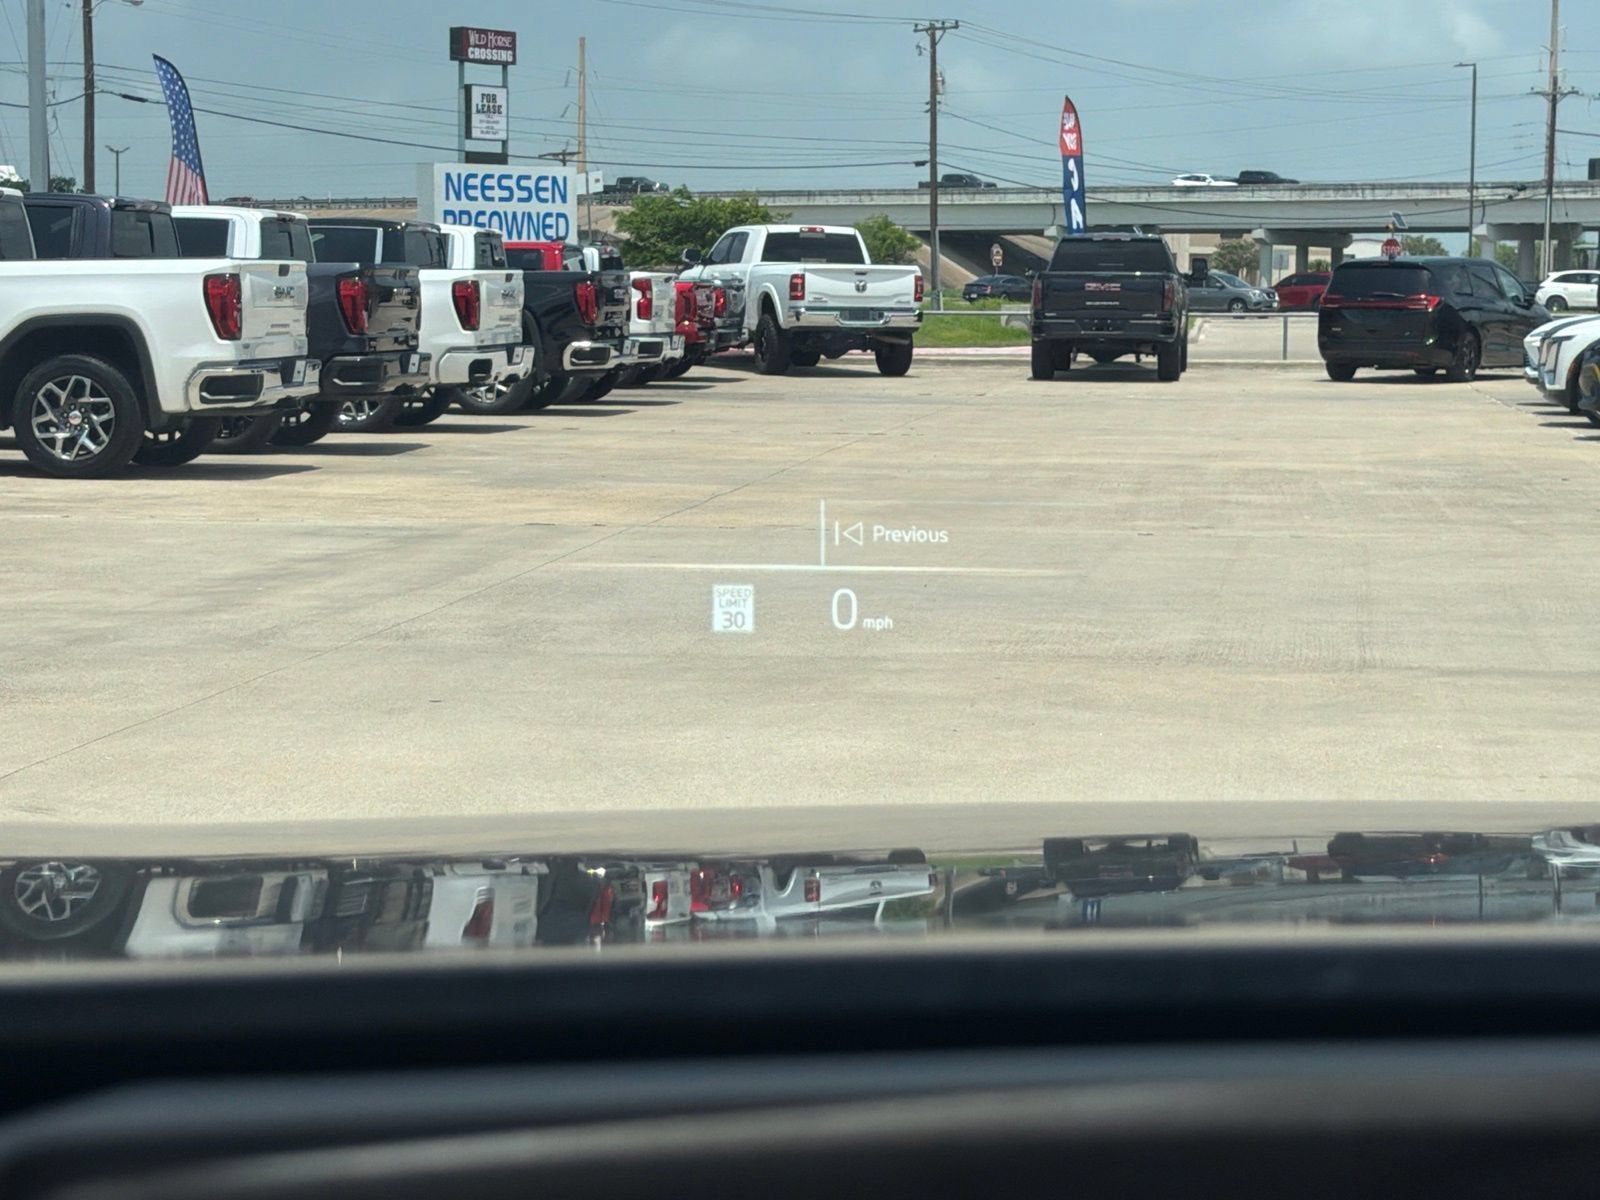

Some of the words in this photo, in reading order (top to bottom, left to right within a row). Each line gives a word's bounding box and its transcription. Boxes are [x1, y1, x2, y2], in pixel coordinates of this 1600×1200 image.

[467, 47, 513, 62] CROSSING
[481, 93, 497, 104] FOR
[476, 103, 502, 115] LEASE
[445, 172, 567, 204] NEESSEN
[1383, 245, 1401, 256] STOP
[872, 525, 949, 543] Previous
[716, 587, 751, 598] SPEED
[719, 598, 747, 609] LIMIT
[832, 588, 858, 630] 0
[863, 616, 893, 631] mph
[722, 611, 745, 629] 30
